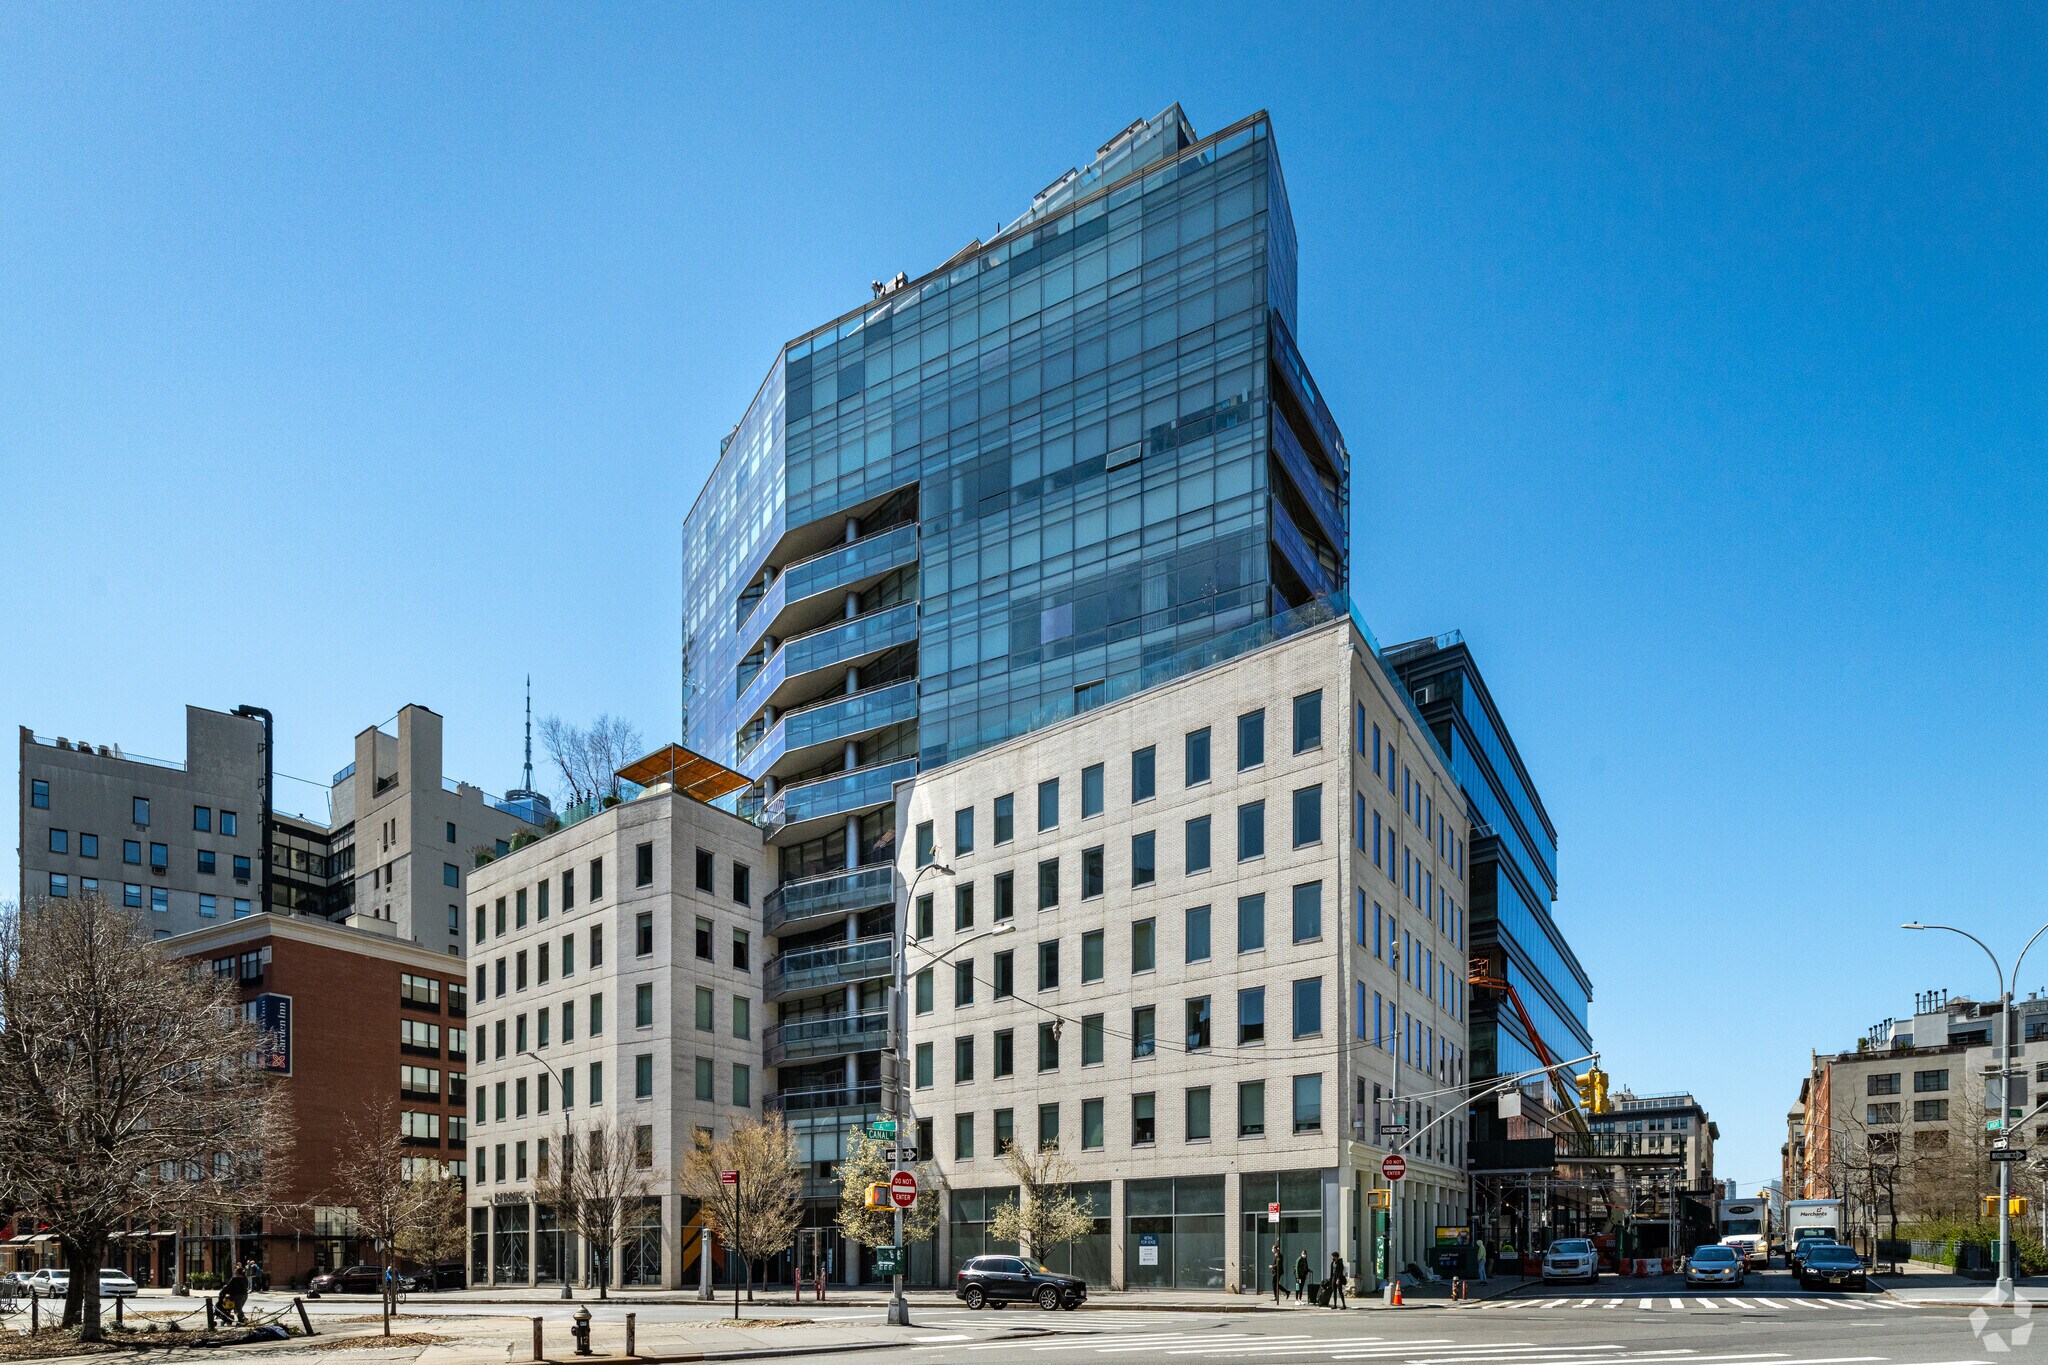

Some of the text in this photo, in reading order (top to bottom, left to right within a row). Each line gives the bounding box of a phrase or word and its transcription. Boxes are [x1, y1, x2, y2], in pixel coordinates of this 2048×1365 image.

[277, 1002, 286, 1054] Garden Inn
[869, 1130, 889, 1140] CANAL
